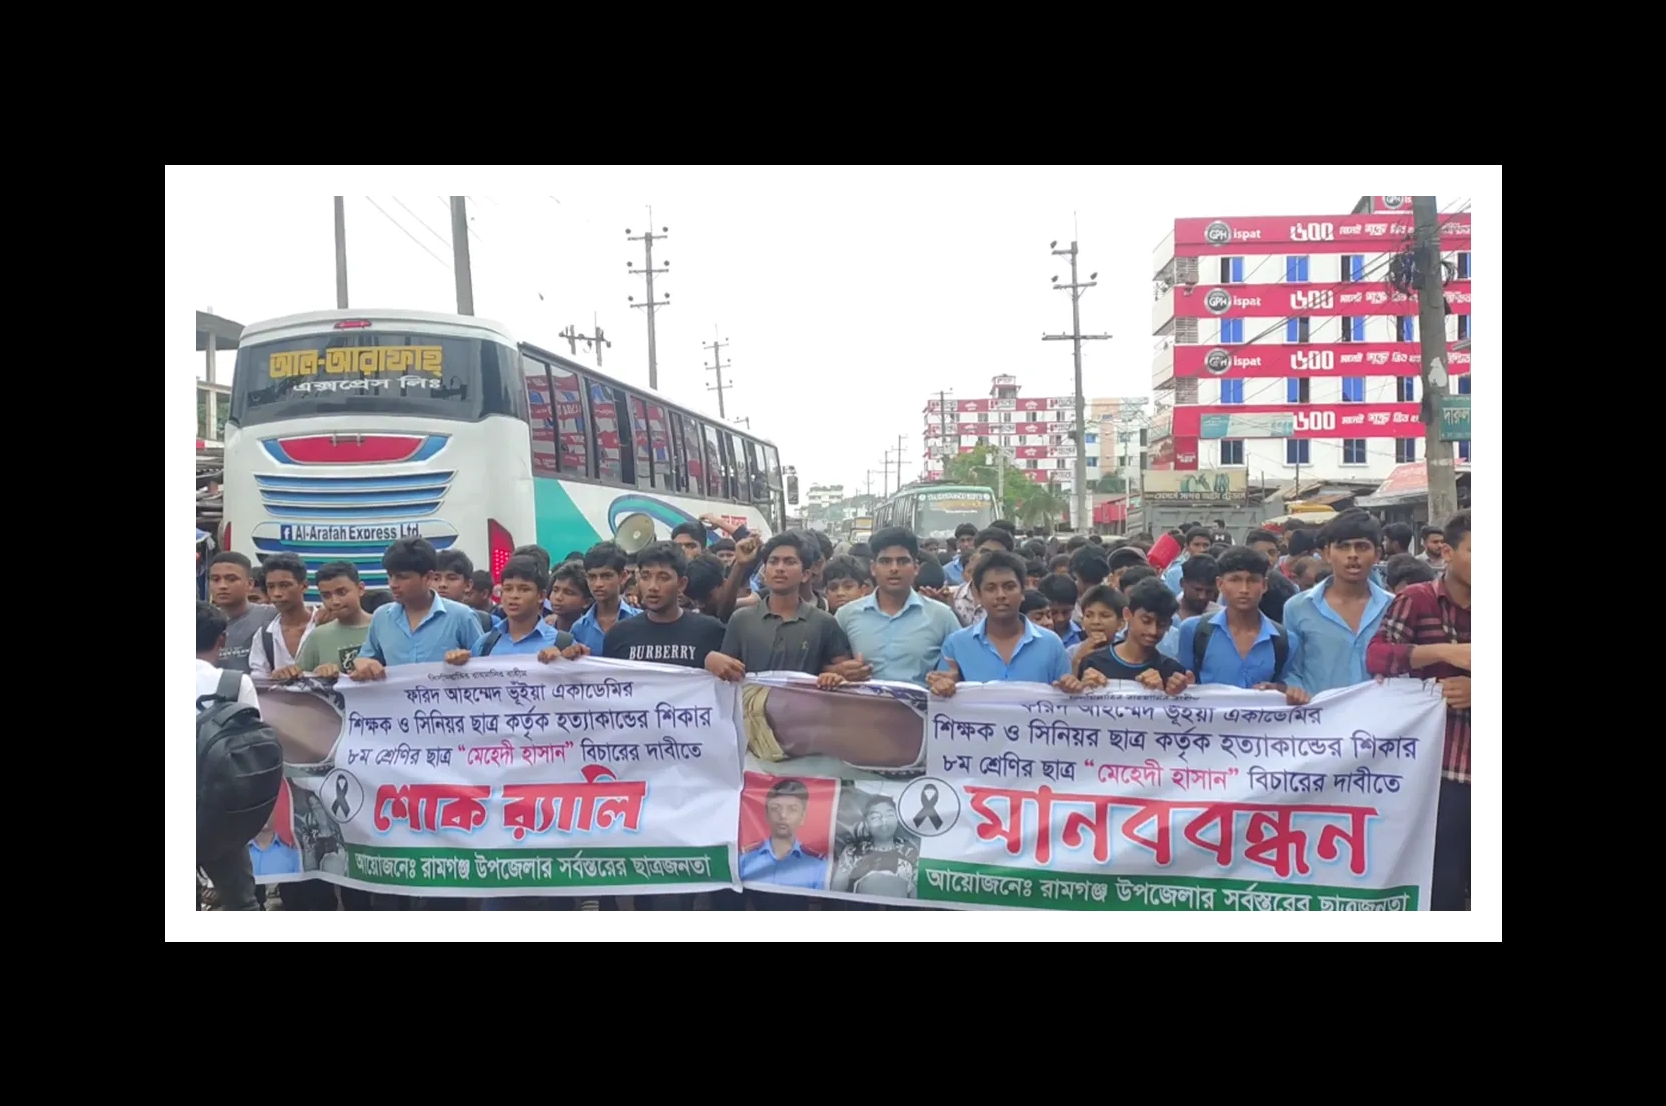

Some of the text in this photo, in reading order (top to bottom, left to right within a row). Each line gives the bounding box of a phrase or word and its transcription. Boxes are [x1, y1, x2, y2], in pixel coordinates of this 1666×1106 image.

[1233, 228, 1262, 242] ispat
[1233, 296, 1262, 309] ispat
[1233, 356, 1262, 369] ispat
[293, 375, 441, 392] এক্সপ্রেস লিঃ
[296, 525, 347, 540] Al-Arafah
[350, 525, 397, 540] Express
[400, 523, 422, 538] Ltd.
[629, 645, 696, 660] BURBERRY
[404, 677, 634, 706] ফরিদ আহম্মেদ ভূঁইয়া একাডেমির
[348, 701, 713, 741] শিক্ষক ও সিনিয়র ছাত্র কর্তৃক হত্যাকান্ডের শিকার
[348, 747, 373, 766] ৮ম
[375, 742, 422, 767] শ্রেণির
[426, 747, 454, 768] ছাত্র
[580, 737, 641, 763] বিচারের
[644, 735, 703, 762] দাবীতে
[933, 713, 1420, 763] শিক্ষক ও সিনিয়র ছাত্র কর্তৃক হত্যাকান্ডের শিকার
[943, 754, 973, 775] ৮ম
[979, 751, 1034, 779] শ্রেণির
[1041, 758, 1077, 782] ছাত্র
[1247, 765, 1328, 793] বিচারের
[1334, 765, 1403, 794] দাবীতে
[373, 783, 492, 833] শোক
[963, 784, 1379, 878] মানববন্ধন
[354, 849, 711, 881] আয়োজনেঃ রামগঞ্জ উপজেলার সর্বস্তরের ছাত্রজনতা
[925, 868, 1032, 898] আয়োজনেঃ
[1039, 877, 1107, 903] রামগঞ্জ
[1115, 877, 1217, 910] উপজেলার
[1221, 883, 1312, 911] সর্বস্তরের
